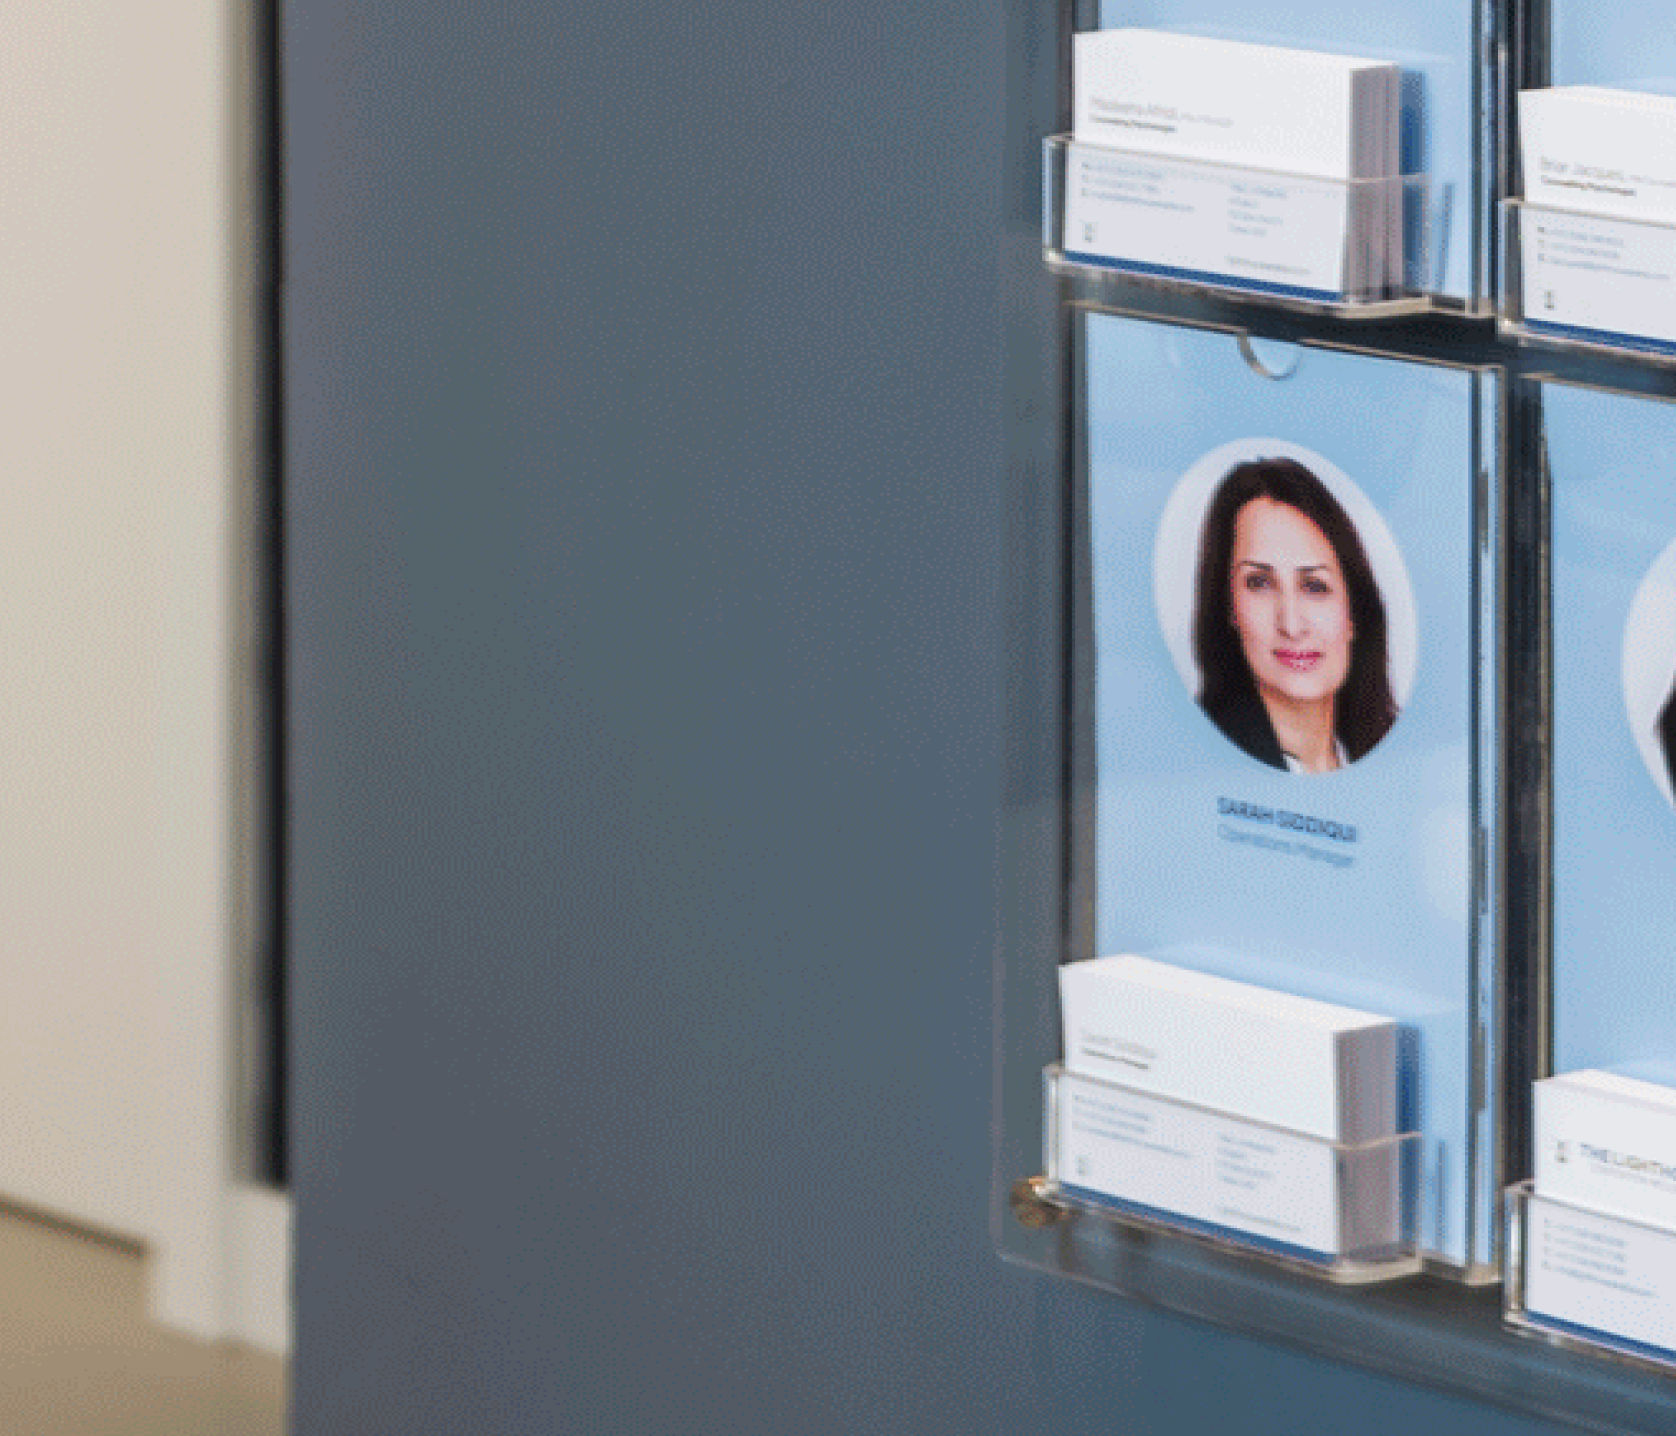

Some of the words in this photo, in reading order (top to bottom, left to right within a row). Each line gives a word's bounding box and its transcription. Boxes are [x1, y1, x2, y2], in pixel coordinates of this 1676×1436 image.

[1216, 794, 1274, 825] SARAH
[1276, 807, 1357, 843] SIDDIQUI
[1580, 1142, 1609, 1163] THE
